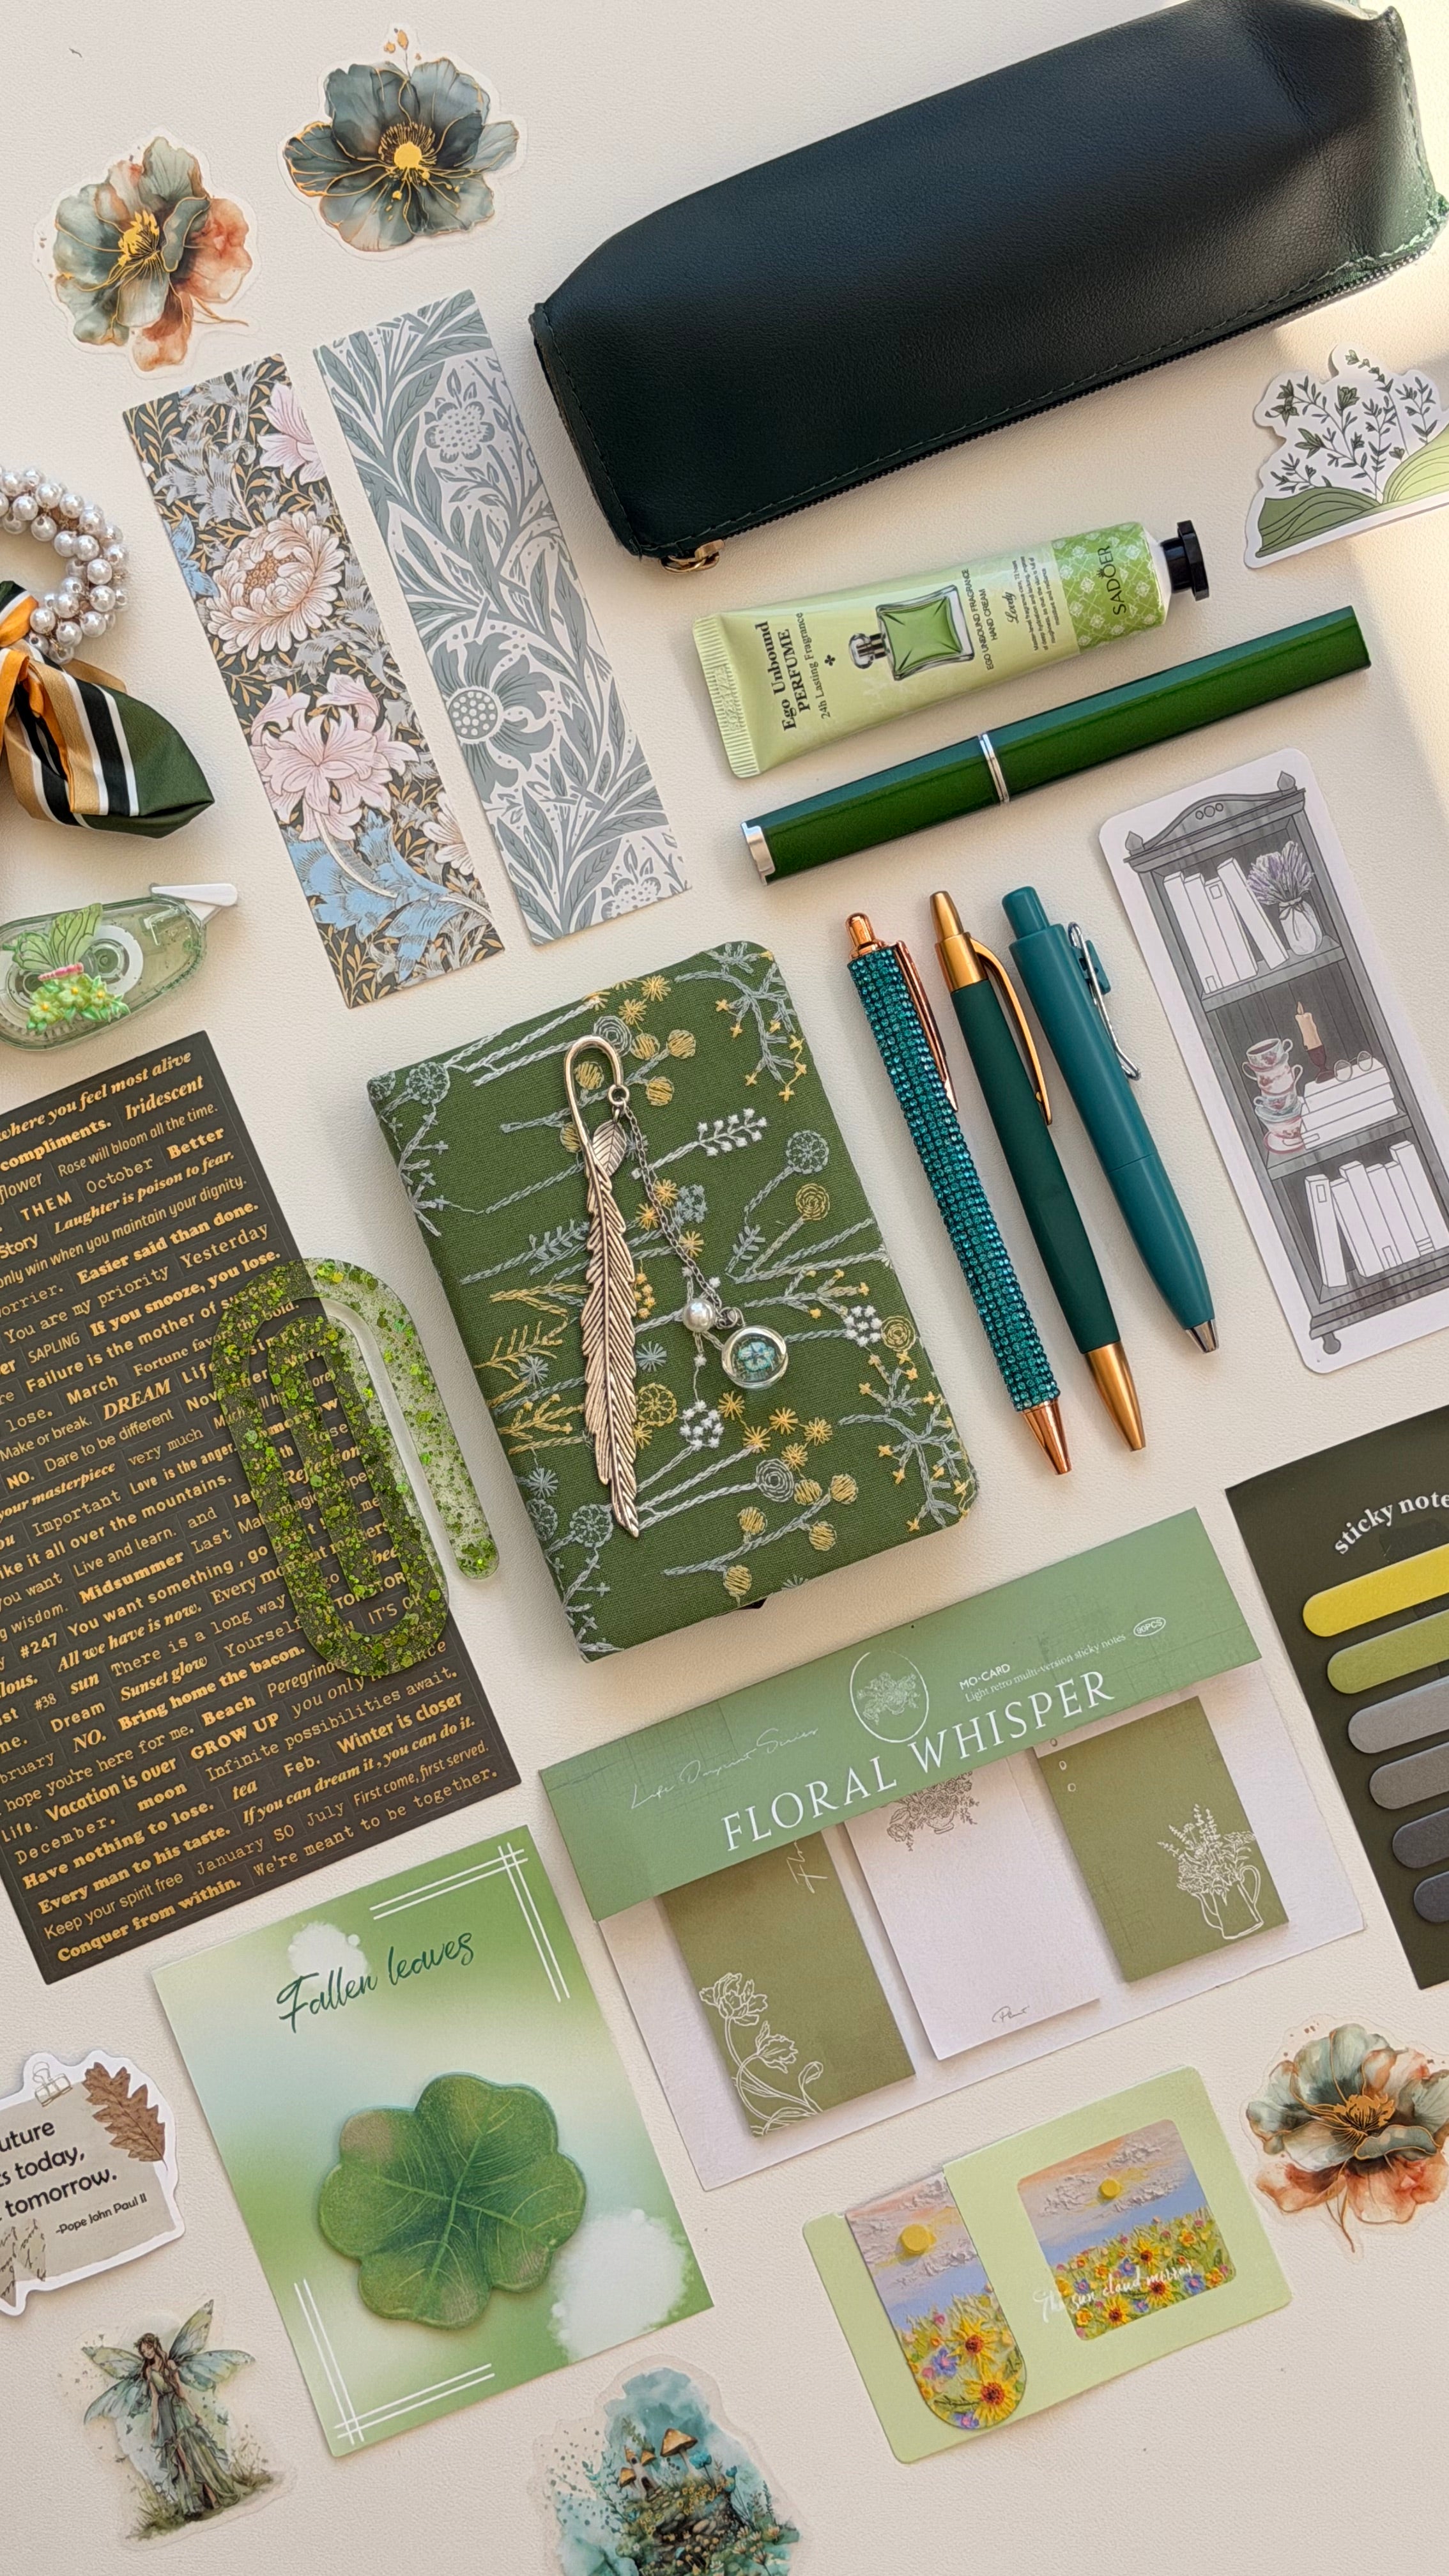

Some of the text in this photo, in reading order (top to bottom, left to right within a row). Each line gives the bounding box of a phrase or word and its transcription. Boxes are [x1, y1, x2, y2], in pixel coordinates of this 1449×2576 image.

[961, 568, 994, 670] EGO UNBOUND FRAGRANCE
[977, 588, 998, 641] HAND CREAM
[754, 620, 797, 732] Ego Unbound
[776, 628, 811, 715] PERFUME
[795, 611, 831, 719] 24h Lasting Fragrance
[47, 1101, 77, 1125] you
[79, 1083, 107, 1112] feel
[110, 1068, 149, 1094] most
[151, 1052, 191, 1077] alive
[125, 1075, 204, 1120] Iridescent
[0, 1119, 112, 1171] compliments.
[57, 1103, 218, 1177] Rose will bloom all the time.
[166, 1127, 224, 1160] Better
[54, 1151, 234, 1234] Laughter is poison to fear.
[86, 1158, 153, 1193] October
[19, 1190, 72, 1221] THEM
[24, 1176, 247, 1276] win when you maintain your dignity.
[75, 1202, 259, 1285] Easier said than done.
[179, 1223, 267, 1268] Yesterday
[3, 1266, 168, 1344] You are my priority
[89, 1251, 280, 1337] If you snooze, you lose.
[27, 1331, 80, 1363] SAPLING
[66, 1374, 119, 1405] March
[102, 1377, 171, 1421] DREAM
[0, 1415, 92, 1462] Make or break.
[127, 1428, 204, 1466] very much
[31, 1489, 121, 1537] Important
[187, 1506, 218, 1529] and
[1334, 1505, 1393, 1554] sticky
[73, 1528, 177, 1577] Live and learn.
[190, 1528, 232, 1554] Last
[78, 1551, 184, 1604] Midsummer
[57, 1603, 202, 1673] All we have is now.
[223, 1615, 302, 1658] Yourself
[117, 1646, 305, 1731] Bring home the bacon.
[120, 1655, 208, 1701] Sunset glow
[964, 1634, 1126, 1703] Light retro multi-version sticky notes
[50, 1702, 105, 1733] Dream
[201, 1695, 256, 1726] Beach
[204, 1666, 457, 1781] Infinite possibilities await.
[335, 1692, 462, 1754] Winter is closer
[283, 1755, 321, 1777] Feb.
[720, 1671, 1116, 1851] FLORAL WHISPER
[137, 1783, 188, 1811] moon
[232, 1780, 258, 1800] tea
[307, 1802, 343, 1827] July
[14, 1817, 116, 1865] December.
[252, 1768, 497, 1876] We're meant to be together.
[197, 1838, 263, 1875] January
[57, 1879, 241, 1961] Conquer from within.
[275, 1932, 474, 2034] Fallen leaves
[14, 2146, 85, 2180] today,
[4, 2168, 117, 2218] tomorrow.
[55, 2218, 88, 2234] -Pope
[88, 2209, 113, 2224] John
[112, 2196, 139, 2214] Paul
